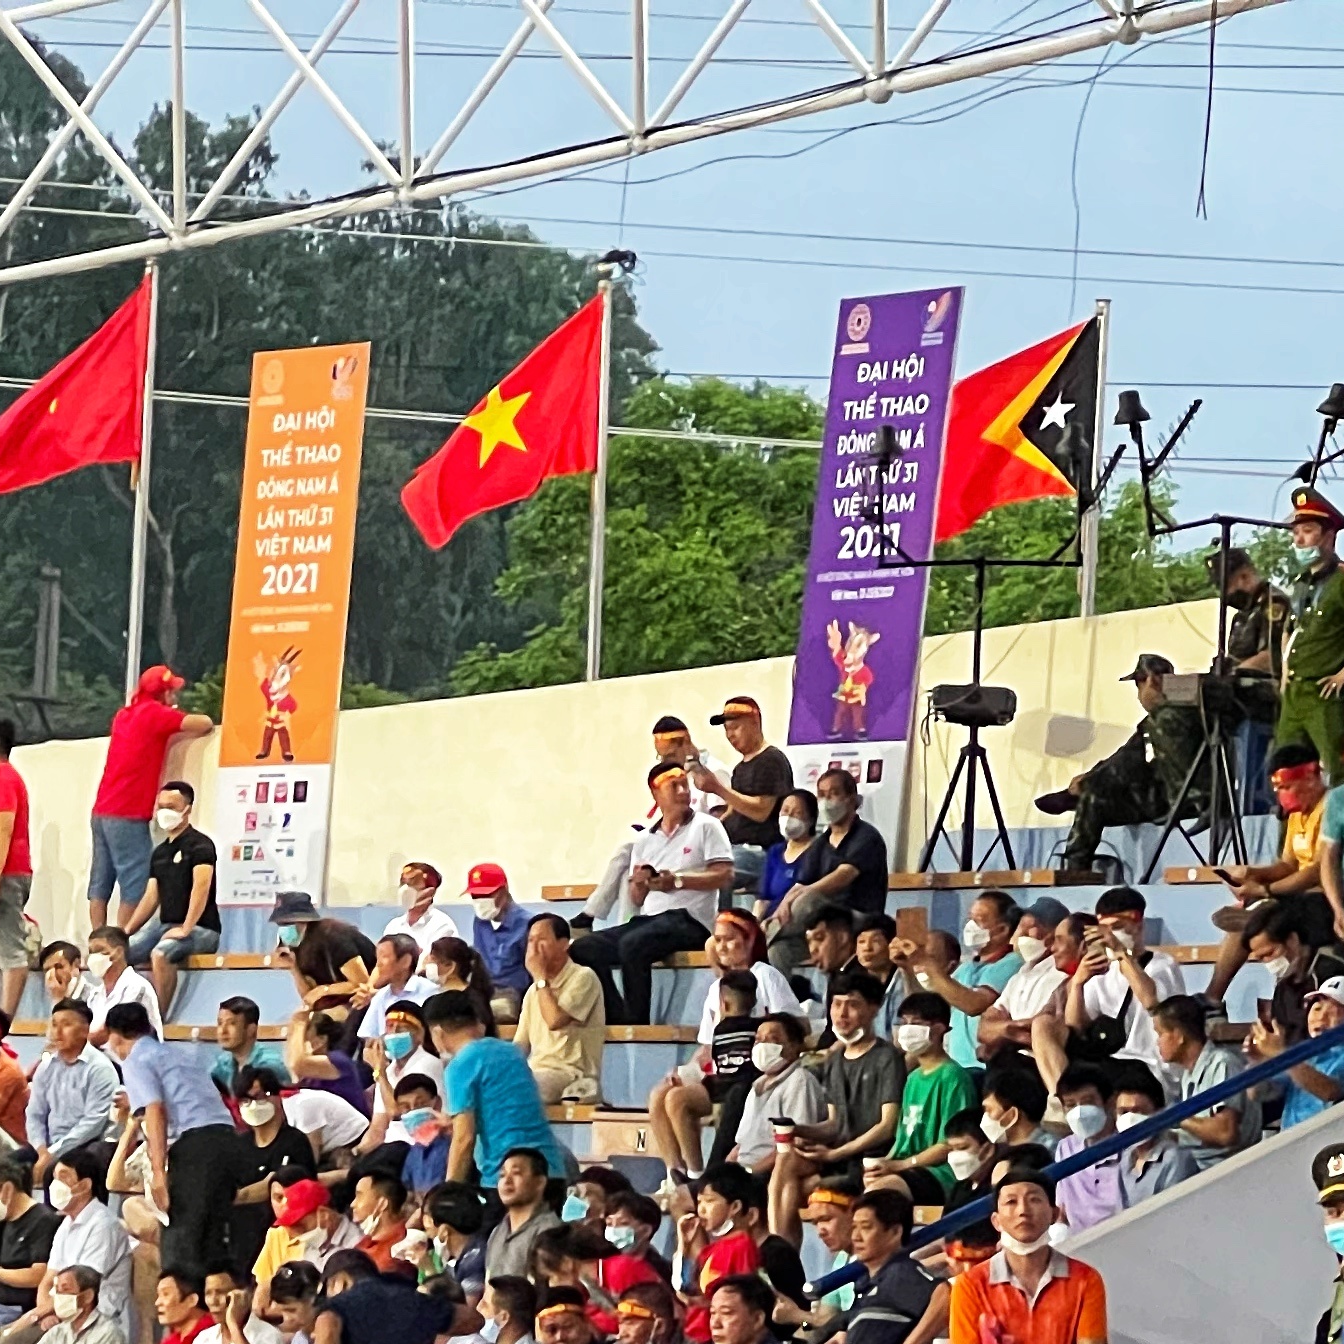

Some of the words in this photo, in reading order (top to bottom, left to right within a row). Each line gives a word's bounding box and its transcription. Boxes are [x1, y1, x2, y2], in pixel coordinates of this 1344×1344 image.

[857, 361, 888, 386] ĐẠI
[891, 353, 925, 383] HỘI
[880, 394, 930, 417] THAO
[273, 411, 302, 436] ĐẠI
[305, 405, 335, 433] HỘI
[913, 422, 925, 449] Á
[296, 444, 341, 464] THAO
[256, 475, 295, 499] ĐÔNG
[296, 476, 326, 496] NAM
[328, 470, 339, 494] Á
[902, 462, 918, 483] 31
[318, 507, 334, 526] 31
[255, 533, 290, 560] VIỆT
[293, 534, 332, 555] NAM
[260, 562, 319, 595] 2021
[636, 1130, 646, 1149] N
